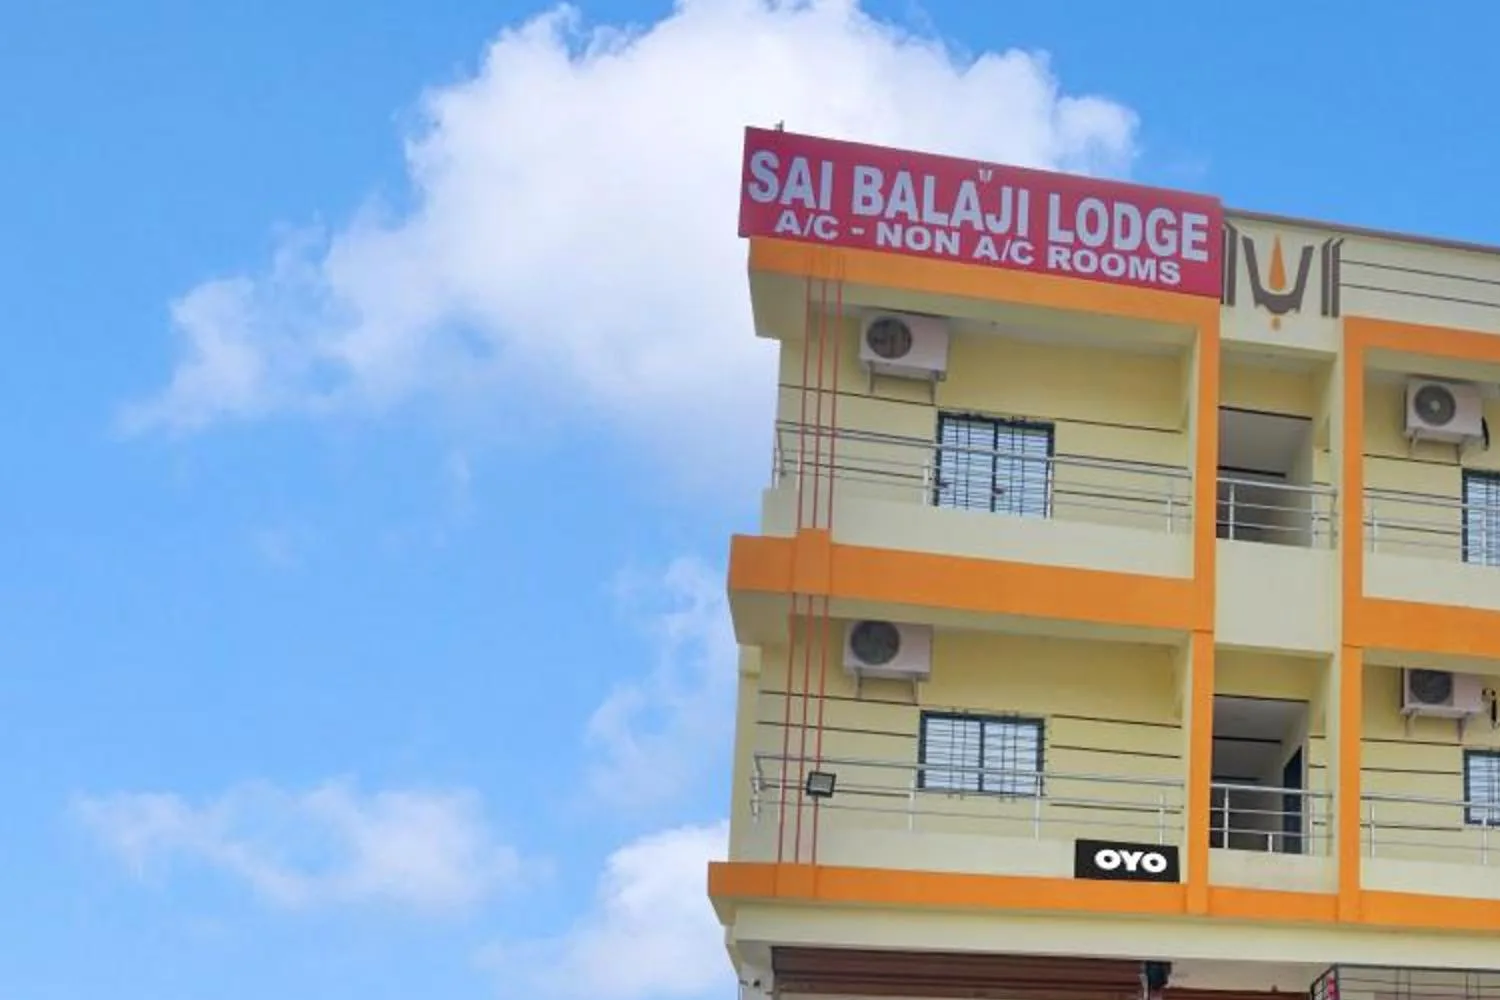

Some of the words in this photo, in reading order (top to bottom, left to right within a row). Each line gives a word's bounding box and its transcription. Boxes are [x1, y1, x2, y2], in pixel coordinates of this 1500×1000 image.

[749, 150, 833, 211] SAI
[852, 164, 1030, 237] BALAJI
[1048, 193, 1209, 263] LODGE
[774, 209, 840, 240] A/C
[876, 221, 960, 256] NON
[972, 235, 1036, 266] A/C
[1047, 245, 1181, 286] ROOMS
[1095, 849, 1167, 873] OYO
